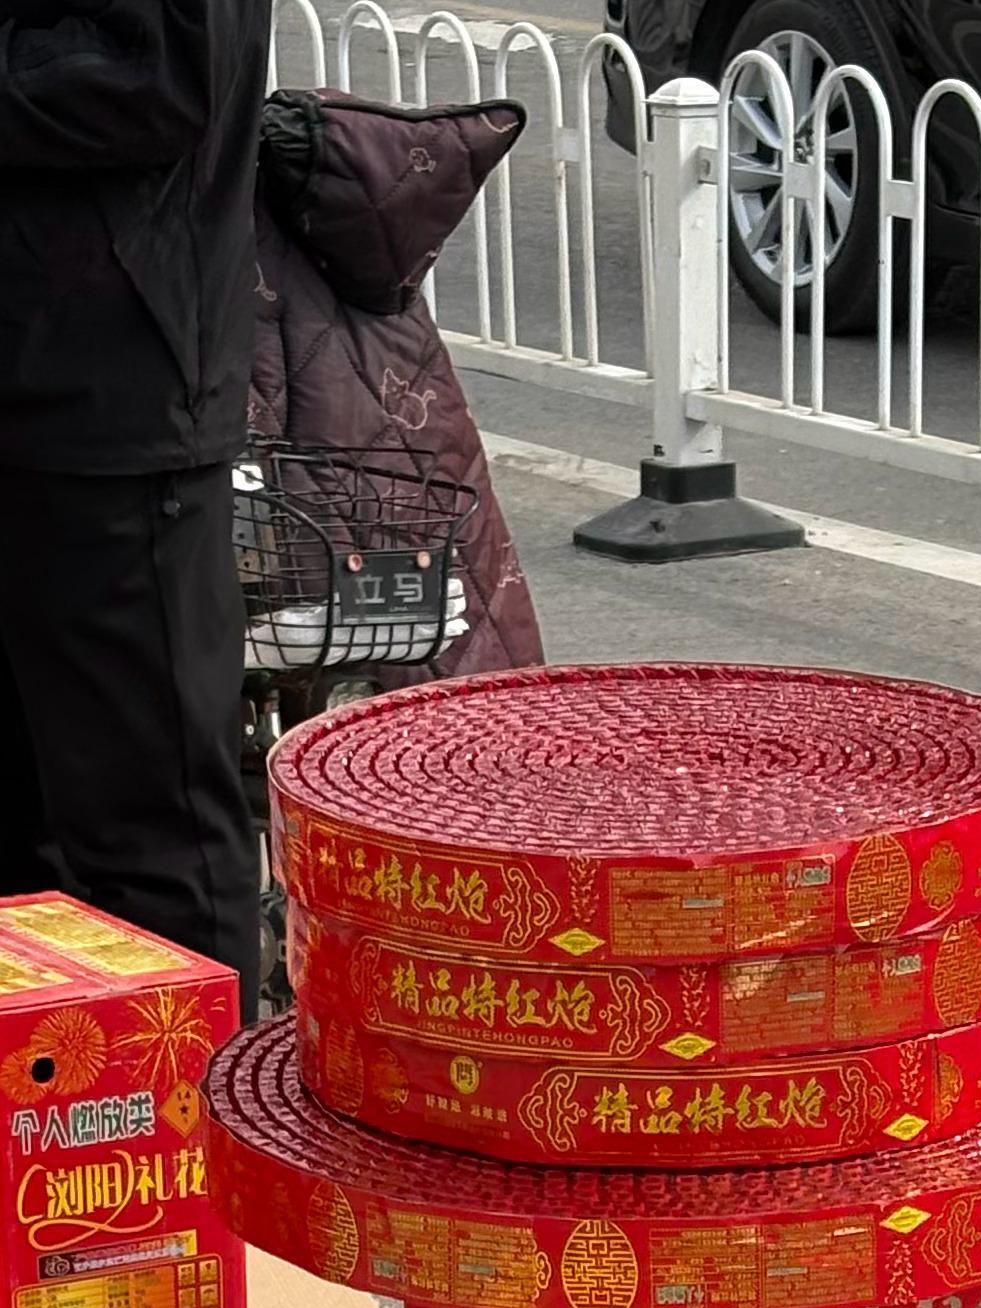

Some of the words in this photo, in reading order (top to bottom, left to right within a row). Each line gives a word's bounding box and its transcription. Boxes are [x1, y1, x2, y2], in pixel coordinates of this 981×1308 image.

[355, 572, 424, 604] 立马
[391, 959, 598, 1035] 精品特红炮
[12, 1090, 155, 1155] 个人燃放类
[591, 1082, 828, 1135] 精品特红炮
